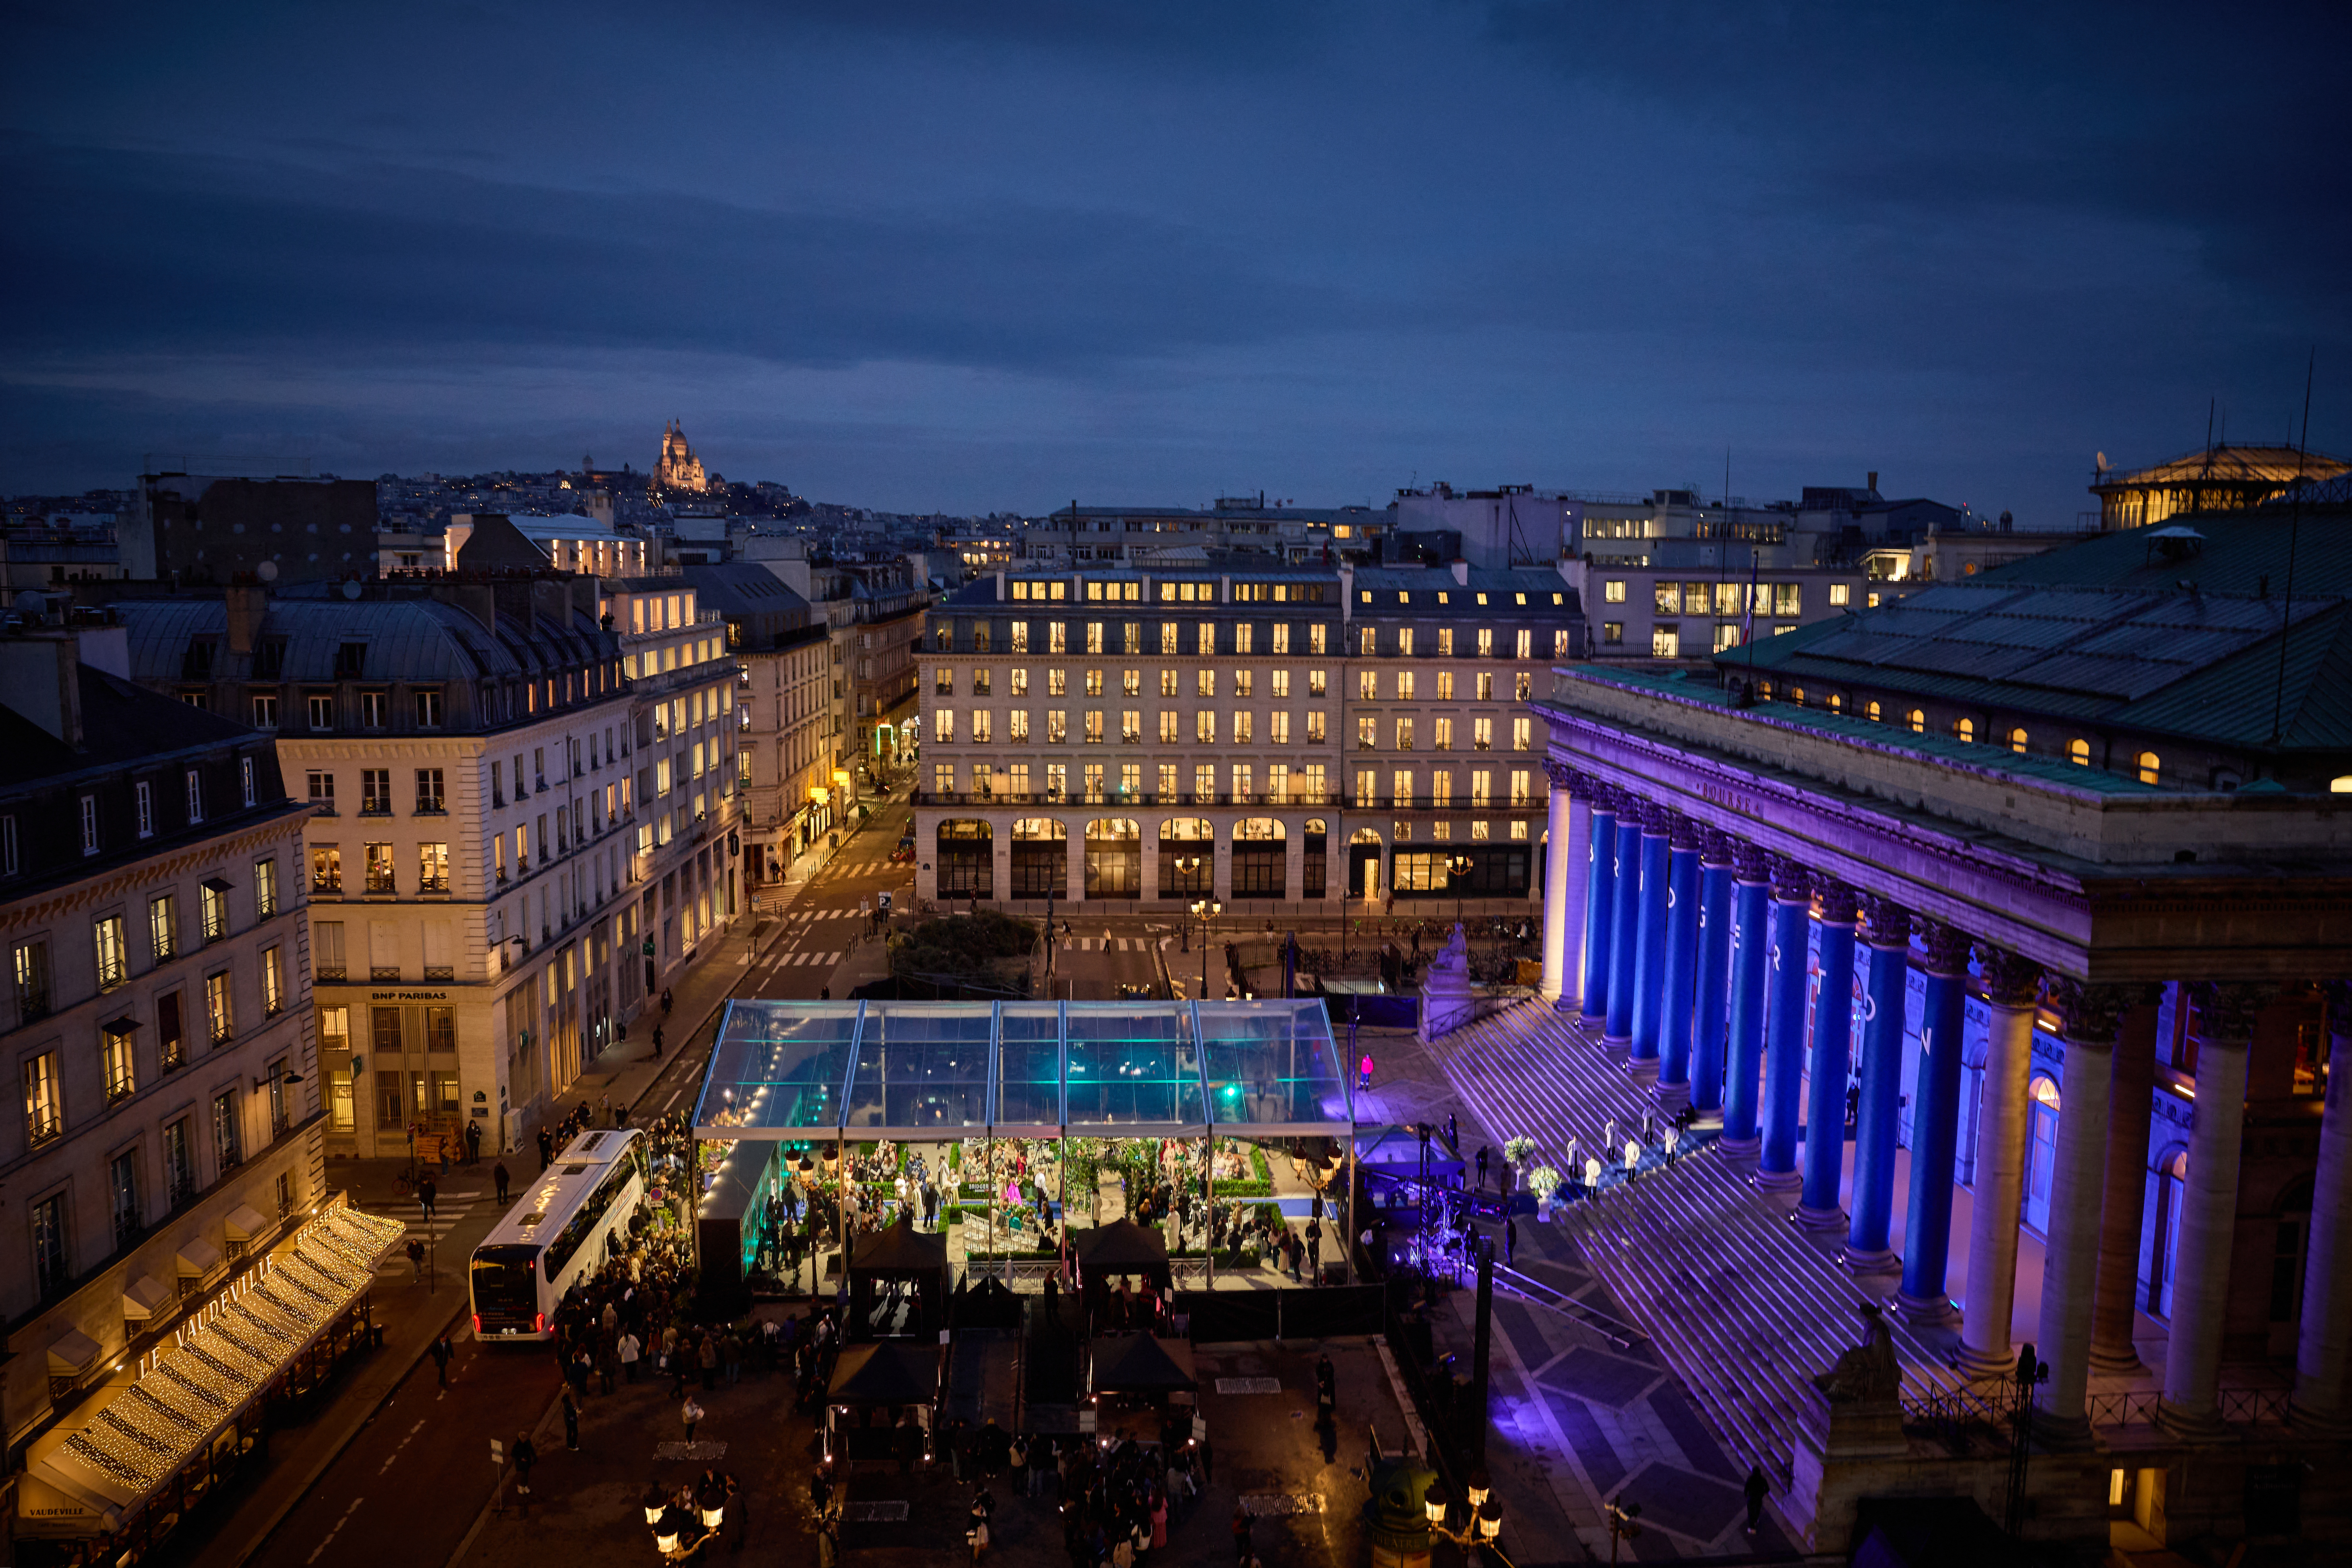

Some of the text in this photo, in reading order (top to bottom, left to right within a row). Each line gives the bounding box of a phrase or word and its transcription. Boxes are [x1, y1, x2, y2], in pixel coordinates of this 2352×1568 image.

[1703, 782, 1750, 813] BOURSE
[139, 1200, 341, 1380] LE VAUDEVILLE BRASSERIE
[249, 1367, 281, 1399] VAUDEVILLE
[30, 1507, 84, 1516] VAUDEVILLE
